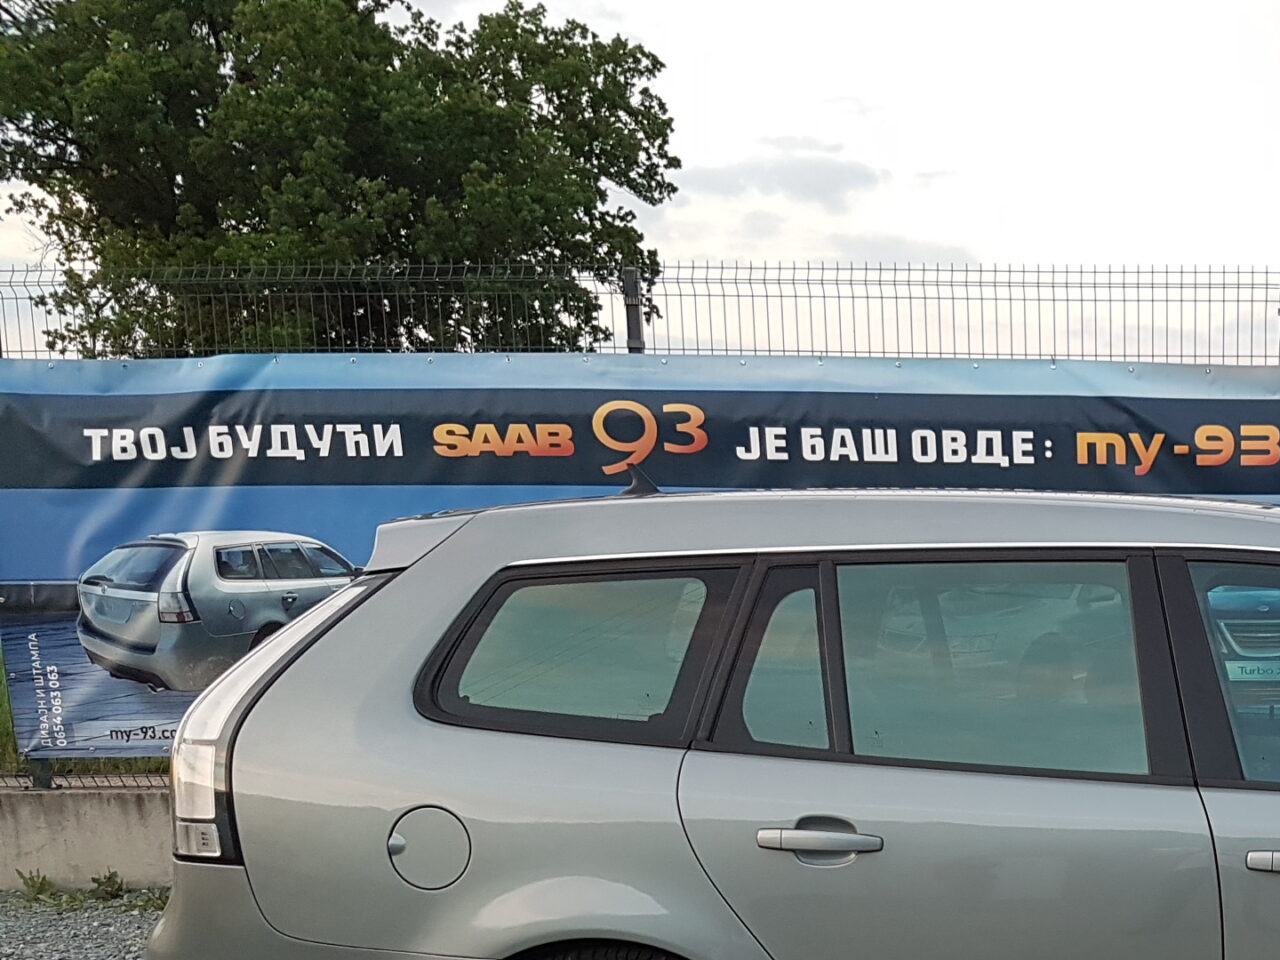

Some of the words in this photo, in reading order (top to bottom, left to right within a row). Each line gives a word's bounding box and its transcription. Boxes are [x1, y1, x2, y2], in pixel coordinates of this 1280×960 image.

[83, 425, 197, 461] ТВОЈ
[208, 423, 404, 461] БУДУЋИ
[432, 422, 575, 457] SAAB
[591, 399, 709, 476] 93
[735, 426, 790, 461] ЈЕ
[800, 426, 899, 463] БАШ
[29, 633, 45, 686] ШТАМПА
[1238, 666, 1273, 676] Turbo
[47, 665, 60, 687] 063
[37, 689, 46, 697] И
[51, 691, 62, 713] 063
[38, 700, 53, 747] ДИЗАЈН
[53, 716, 67, 747] 0654
[110, 726, 177, 743] my-93.co
